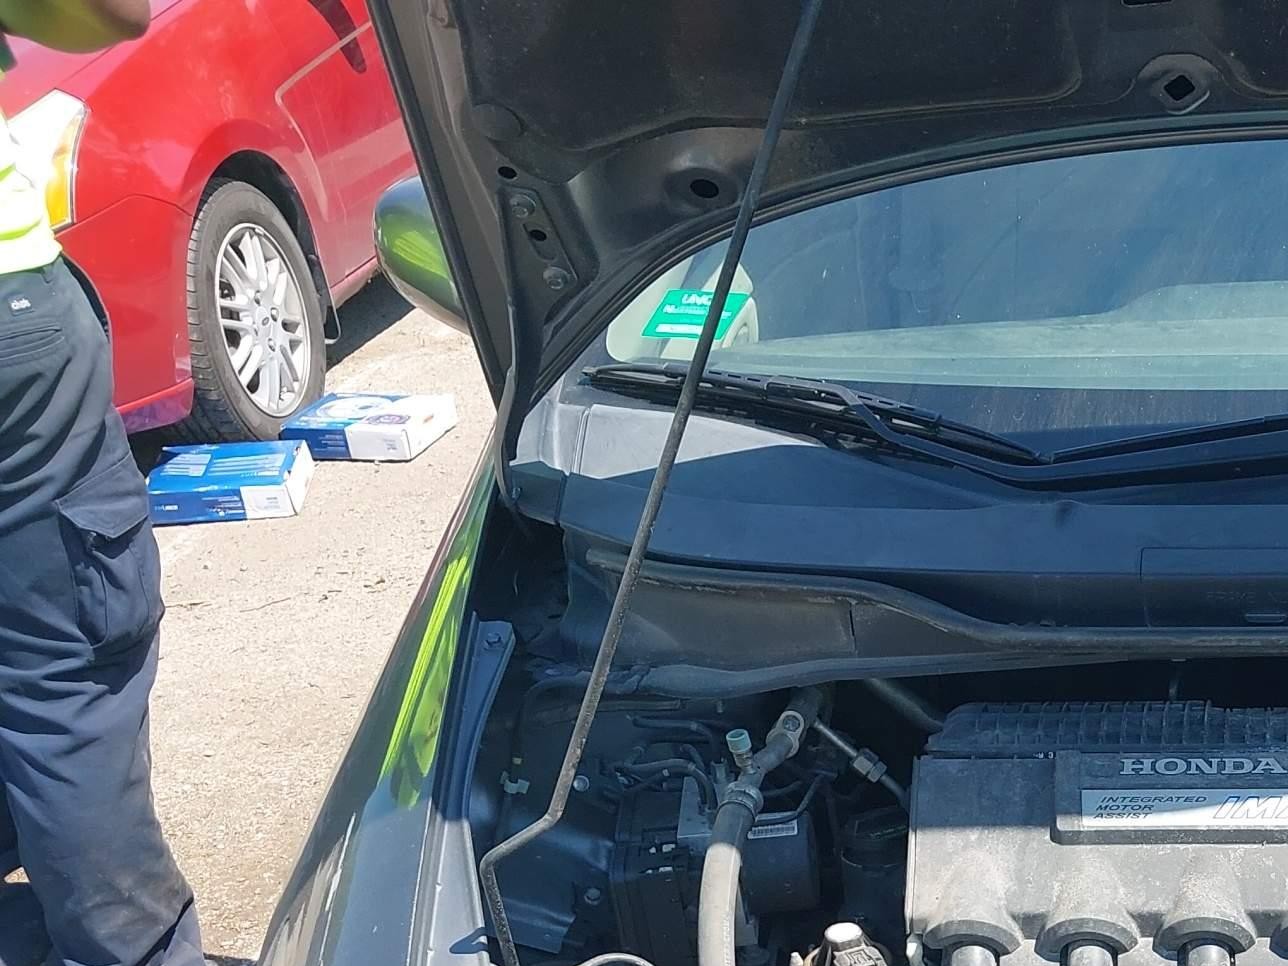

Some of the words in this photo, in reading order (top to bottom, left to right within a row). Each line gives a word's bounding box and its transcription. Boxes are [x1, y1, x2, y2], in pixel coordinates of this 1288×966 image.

[1119, 757, 1288, 776] HONDA
[1095, 804, 1155, 812] MOTOR
[1093, 812, 1152, 820] ASSIST
